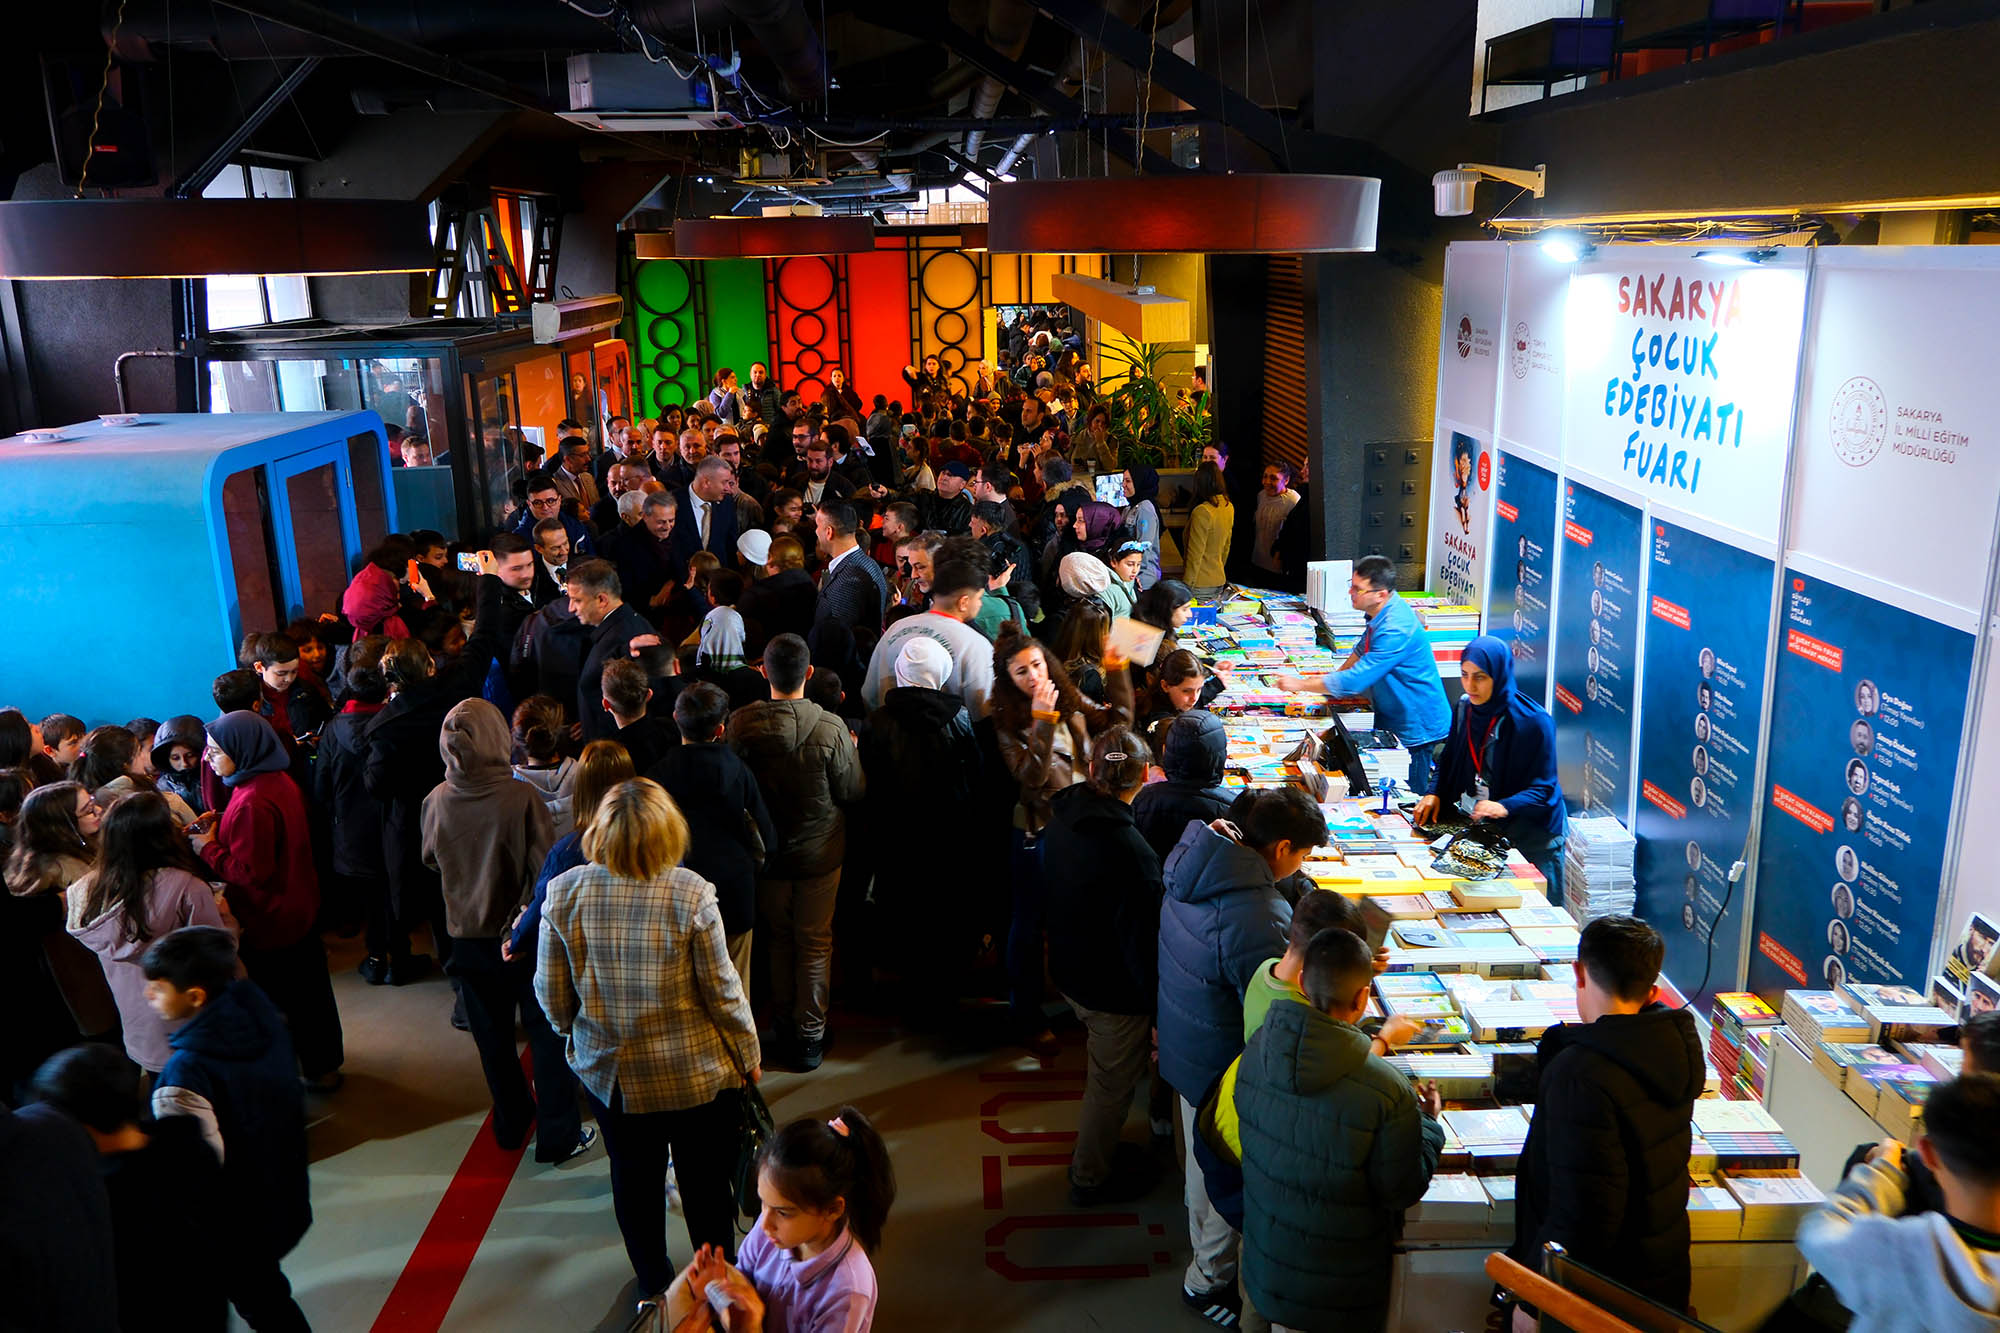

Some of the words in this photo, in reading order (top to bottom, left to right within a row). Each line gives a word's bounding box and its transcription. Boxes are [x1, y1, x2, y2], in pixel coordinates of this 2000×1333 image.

[1618, 272, 1742, 328] SAKARYA
[1632, 327, 1719, 382] ÇOCUK
[1604, 377, 1744, 449] EDEBİYATI
[1897, 406, 1943, 424] SAKARYA
[1894, 423, 1904, 436] İL
[1905, 424, 1931, 441] MİLLİ
[1933, 428, 1969, 448] EĞİTİM
[1623, 430, 1701, 494] FUARI
[1892, 441, 1957, 465] MÜDÜRLÜĞÜ
[1444, 532, 1477, 560] SAKARYA
[1447, 551, 1471, 575] ÇOCUK
[1440, 565, 1476, 599] EDEBİYATI
